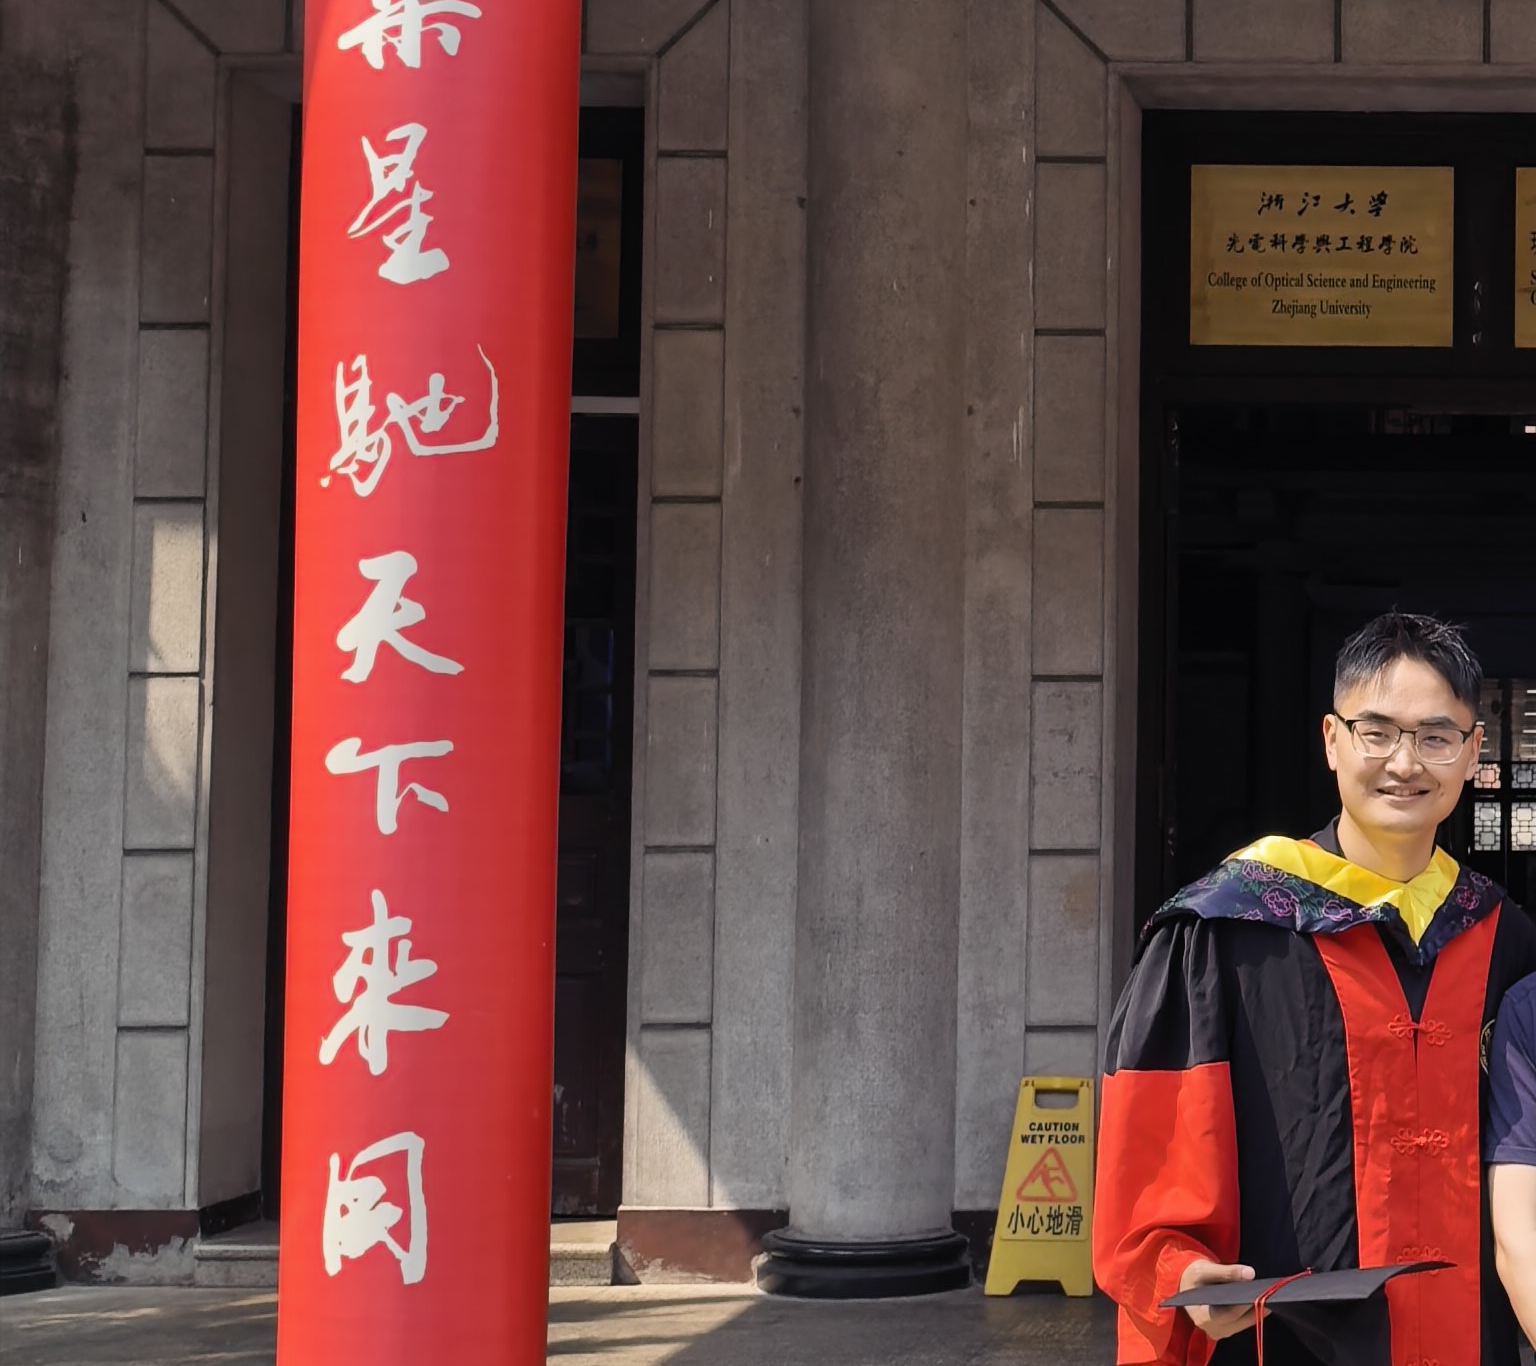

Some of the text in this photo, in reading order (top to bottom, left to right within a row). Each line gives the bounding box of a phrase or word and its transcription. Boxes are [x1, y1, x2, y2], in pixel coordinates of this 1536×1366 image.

[1207, 272, 1437, 293] College of Optical Science and Engineering
[1271, 299, 1372, 319] Zhejiang University
[1028, 1121, 1080, 1132] CAUTION
[1020, 1133, 1086, 1145] WET FLOOR
[1007, 1204, 1084, 1236] 小心地滑
